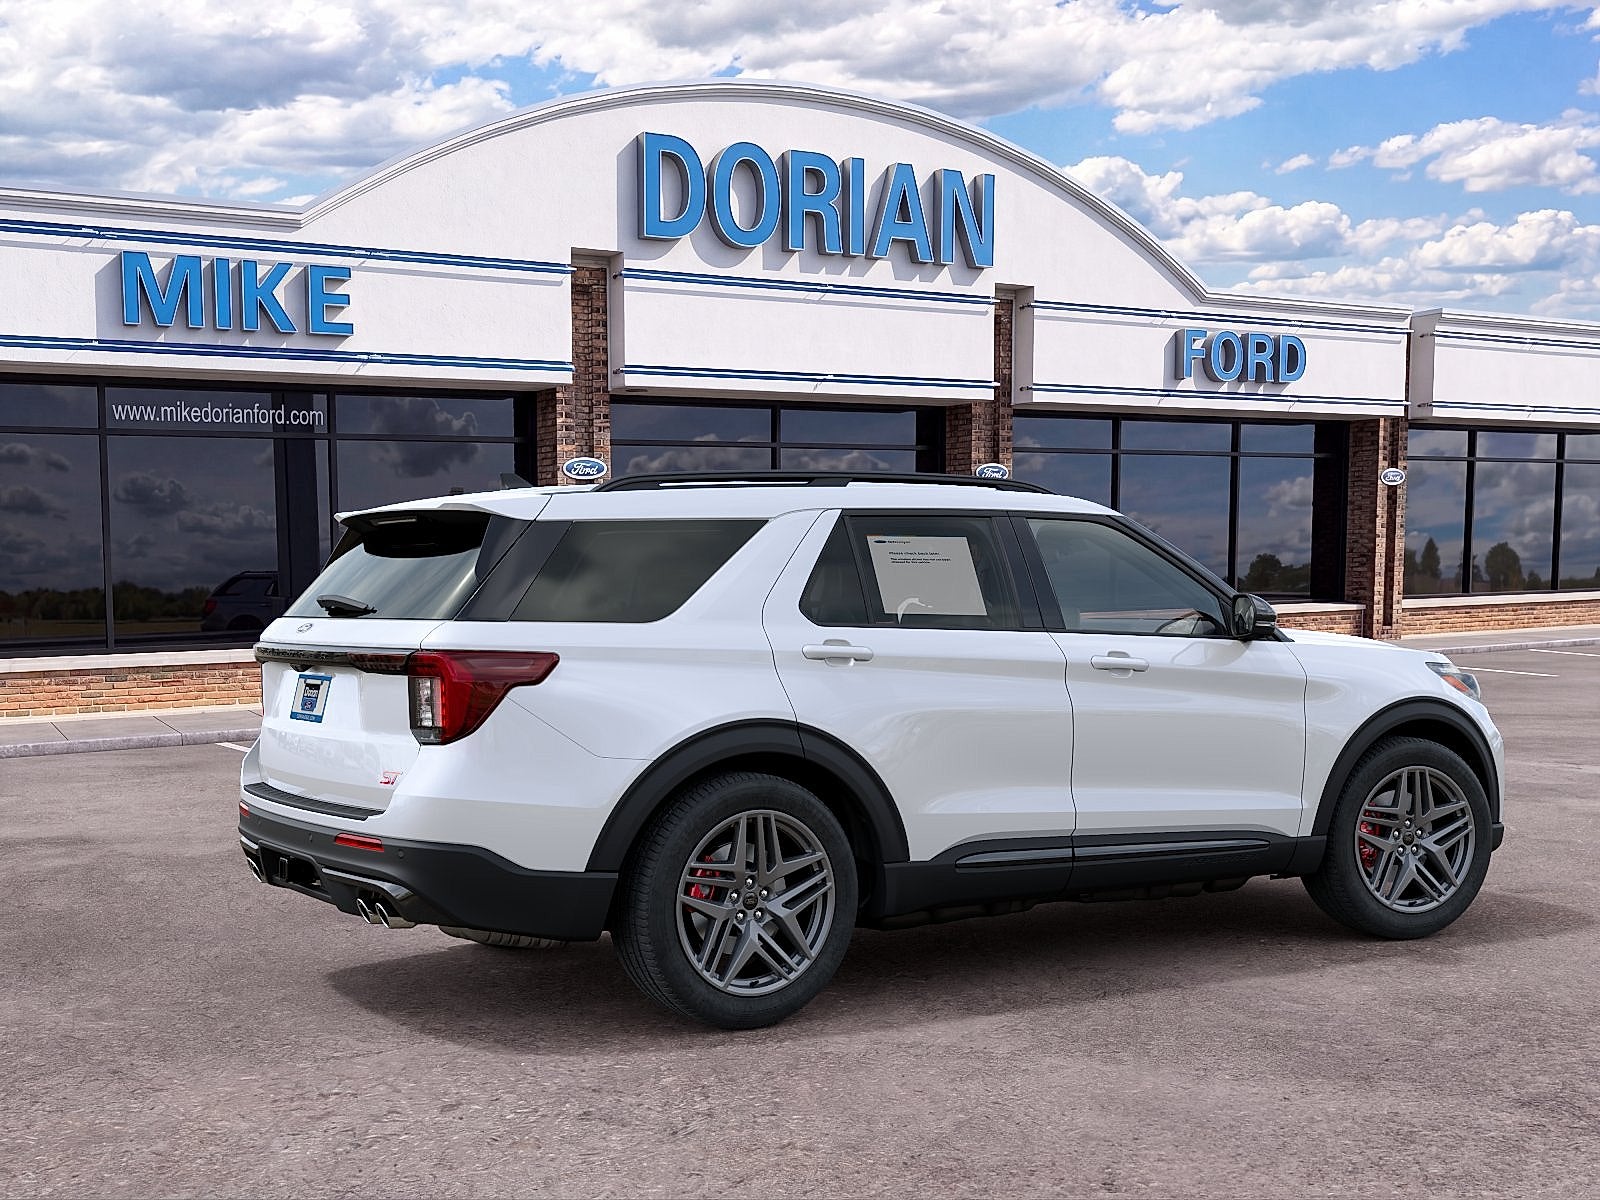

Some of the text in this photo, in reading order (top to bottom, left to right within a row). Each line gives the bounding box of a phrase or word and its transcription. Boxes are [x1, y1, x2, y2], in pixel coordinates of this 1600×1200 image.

[638, 131, 996, 269] DORIAN
[120, 249, 355, 337] MIKE
[1176, 327, 1307, 384] FORD
[111, 400, 325, 426] www.mikedorianford.com
[571, 462, 599, 475] Ford
[982, 467, 1003, 479] Ford
